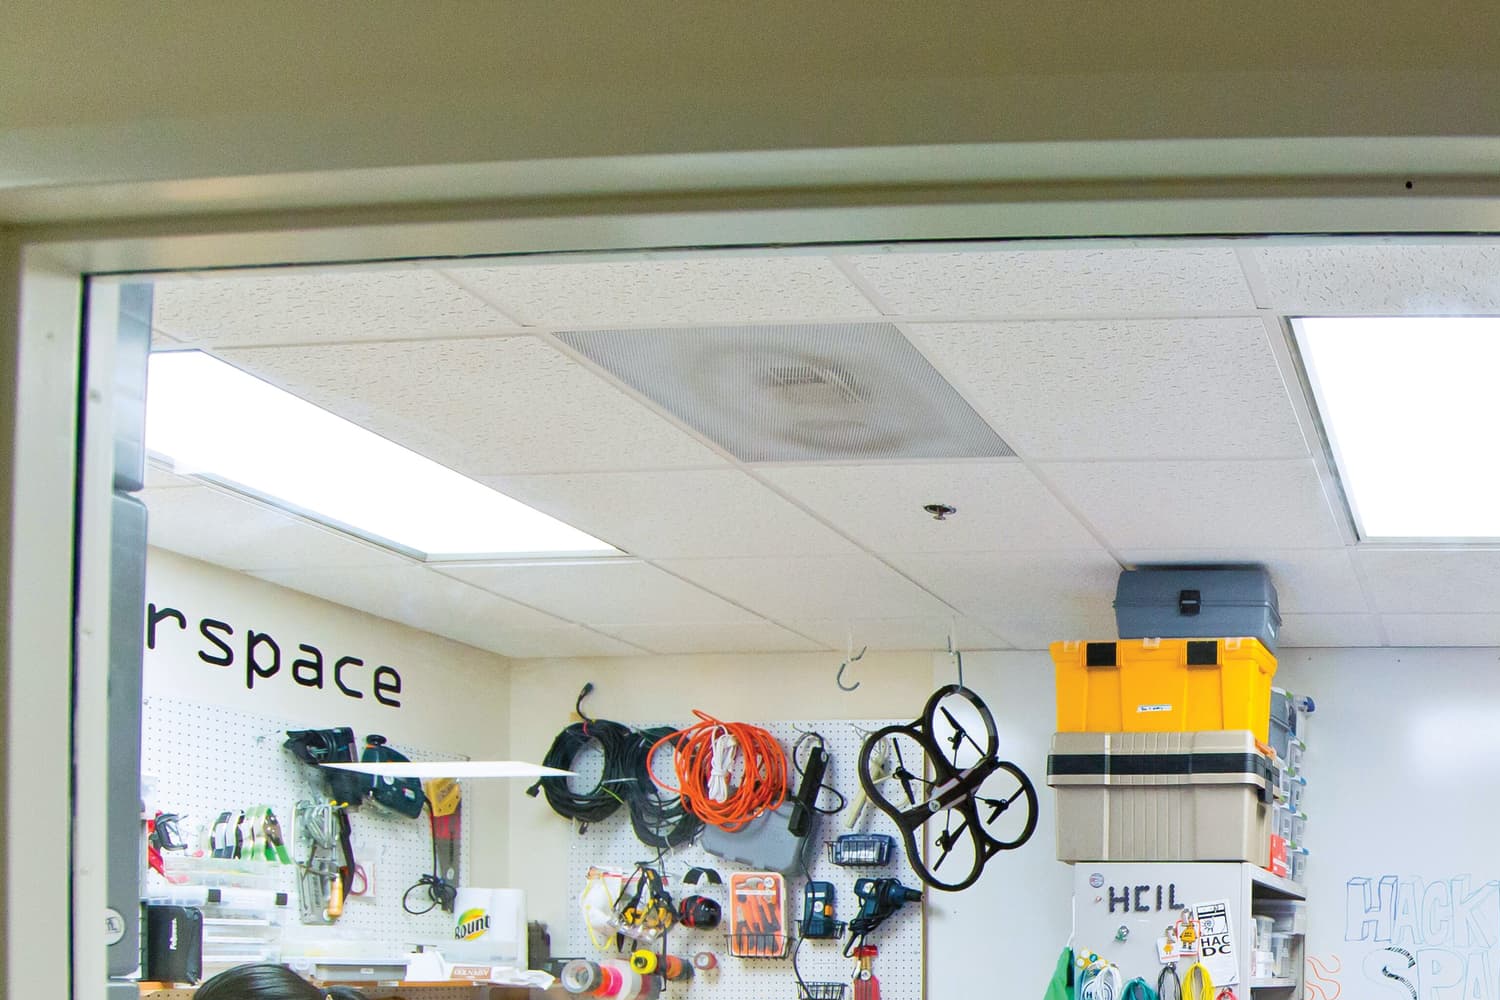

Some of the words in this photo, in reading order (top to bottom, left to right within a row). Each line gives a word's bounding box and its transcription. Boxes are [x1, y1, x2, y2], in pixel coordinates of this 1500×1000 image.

[146, 602, 402, 709] rspace
[1109, 883, 1185, 913] HCIL
[1201, 934, 1231, 947] HAC
[1202, 944, 1232, 957] DC
